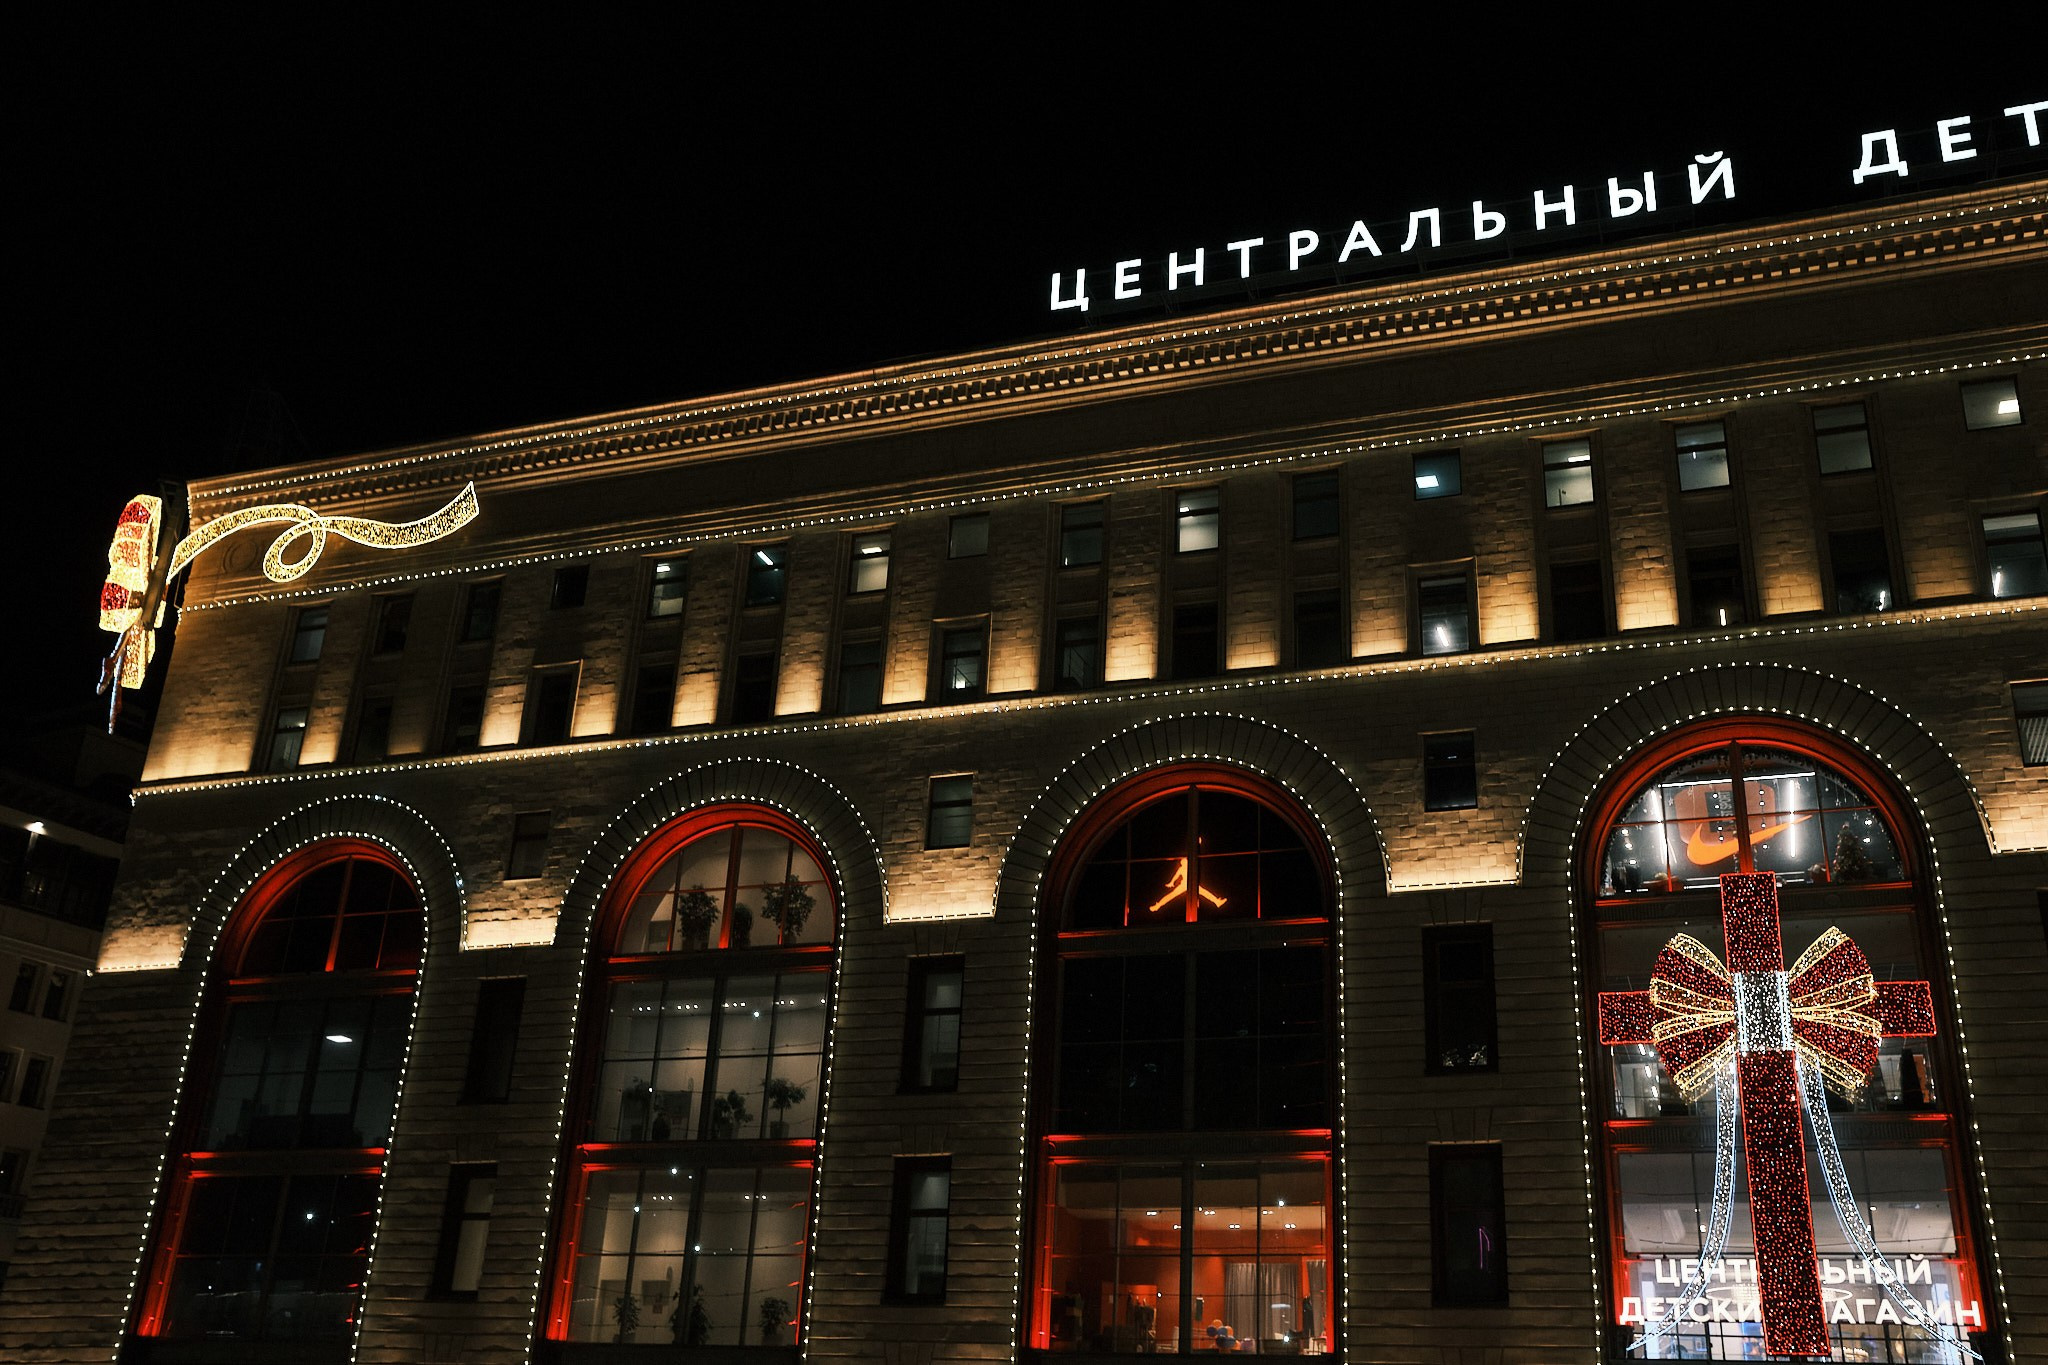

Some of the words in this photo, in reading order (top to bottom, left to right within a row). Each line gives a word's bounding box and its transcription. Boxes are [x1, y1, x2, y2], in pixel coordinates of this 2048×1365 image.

[1050, 150, 1736, 312] ЦЕНТРАЛЬНЫЙ
[1852, 101, 2048, 185] ДЕТ
[1655, 1254, 1933, 1287] ЦЕНТЬНЫЙ
[1619, 1297, 1762, 1326] ДЕТСКИ
[1823, 1298, 1982, 1327] АГАЗИН
